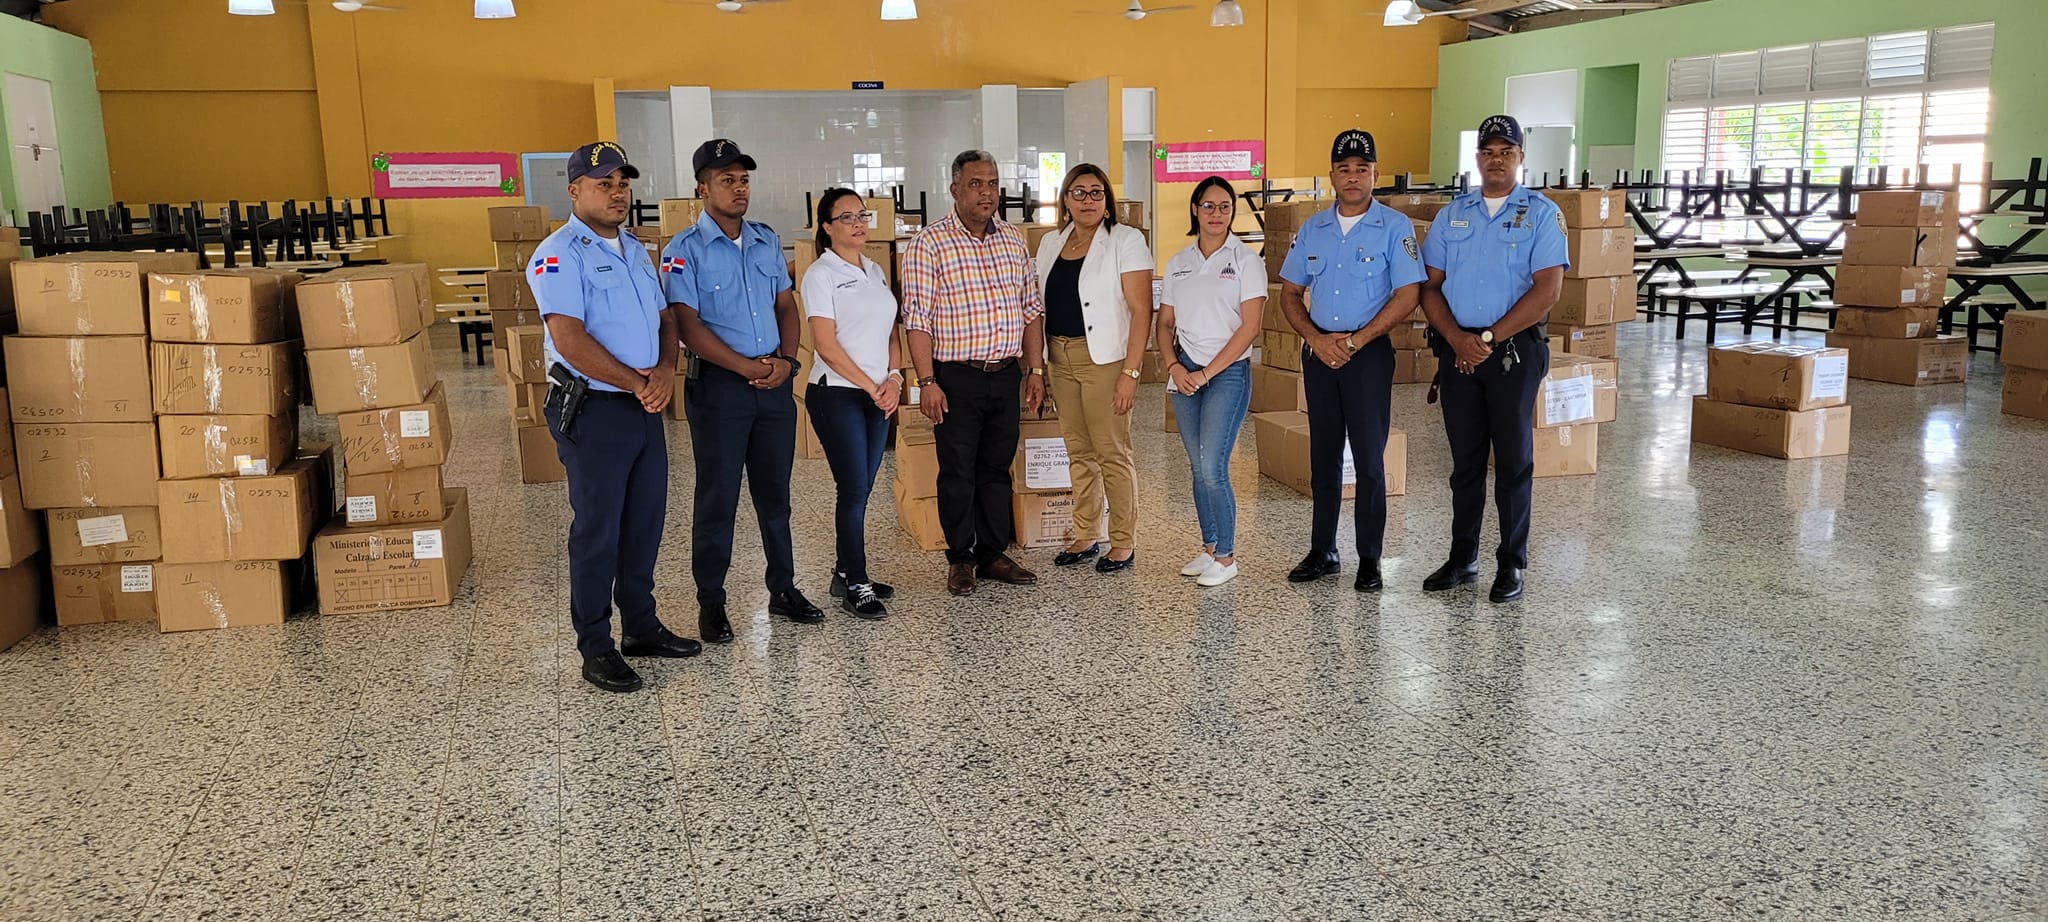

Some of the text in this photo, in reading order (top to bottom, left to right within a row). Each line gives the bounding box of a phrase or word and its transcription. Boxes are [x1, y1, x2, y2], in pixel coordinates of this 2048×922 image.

[1337, 134, 1351, 154] POLICIA
[591, 143, 604, 167] POLICIA
[94, 269, 132, 279] 02532
[44, 278, 55, 289] 10
[228, 365, 272, 377] 02532
[20, 406, 65, 418] 02532
[114, 402, 127, 413] 13
[362, 414, 371, 424] 18
[27, 427, 67, 437] 02532
[180, 425, 196, 436] 20
[229, 436, 259, 446] 02532
[187, 492, 199, 501] 14
[248, 489, 290, 498] 02532
[345, 550, 415, 562] Calzado Escolar
[234, 562, 277, 571] 02532
[62, 568, 100, 579] 02532
[185, 573, 193, 582] 11
